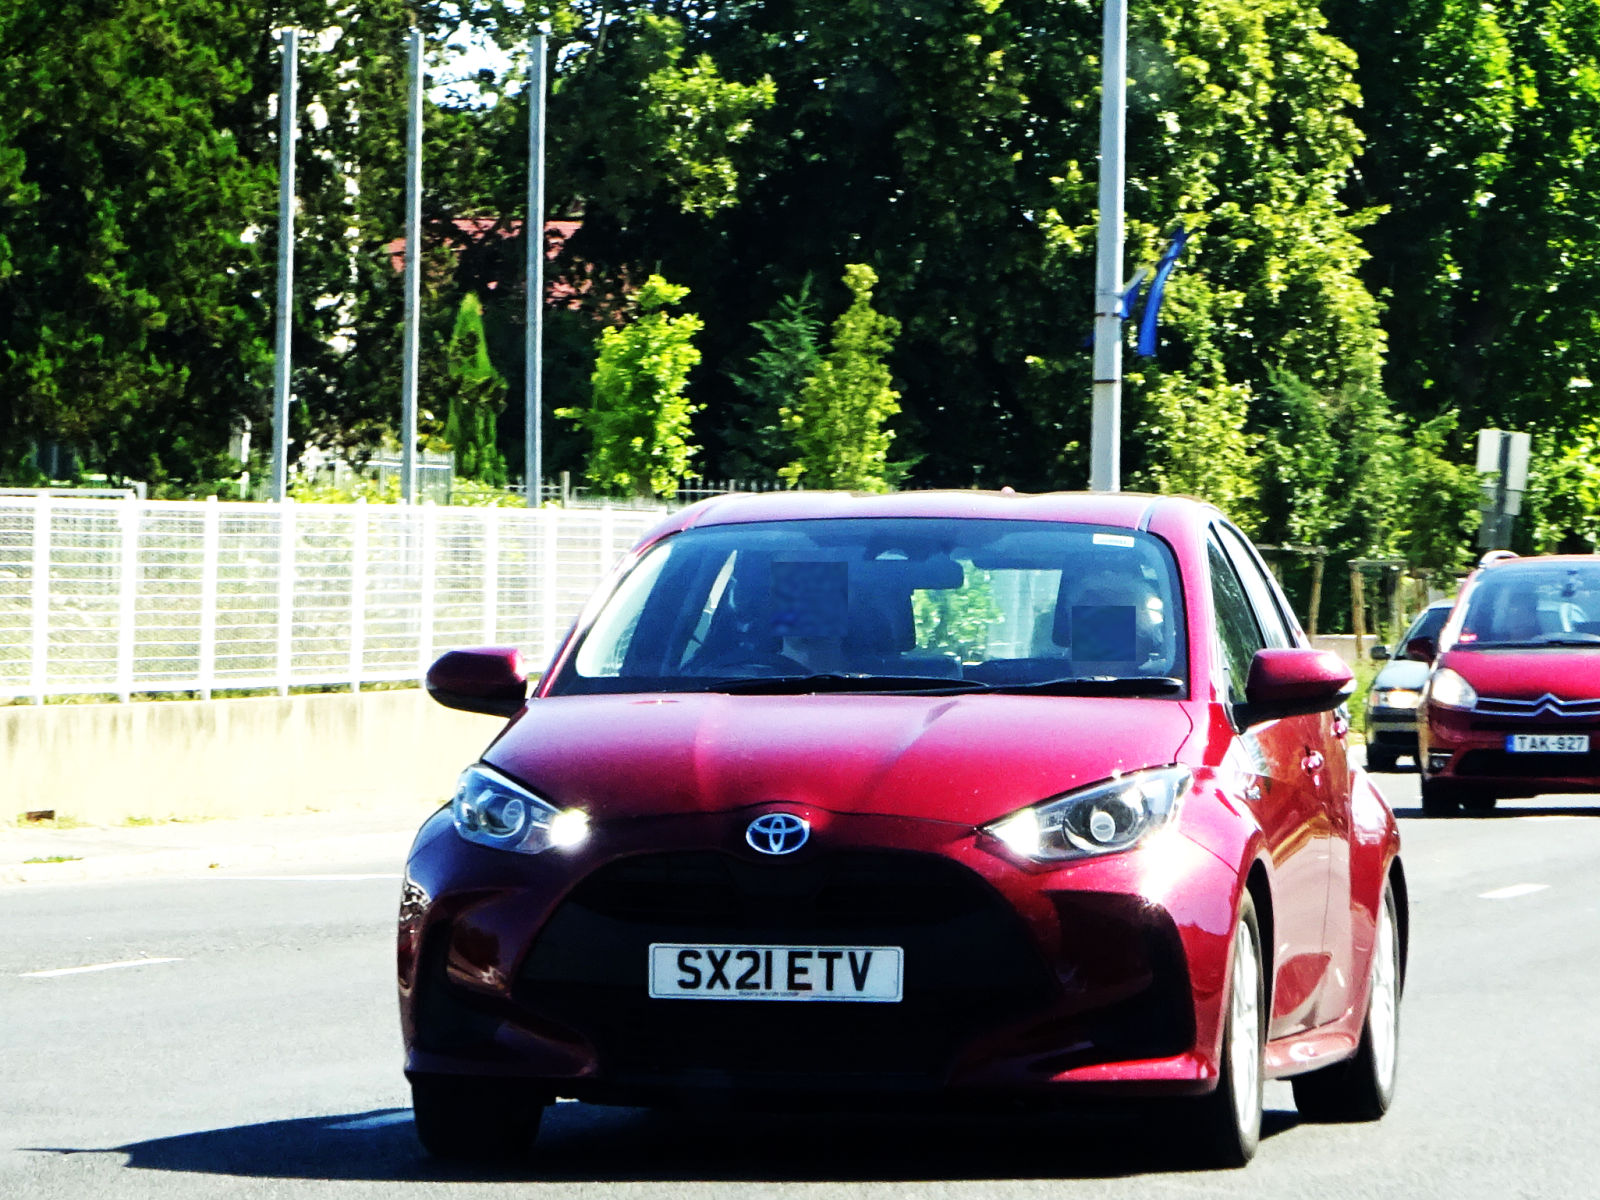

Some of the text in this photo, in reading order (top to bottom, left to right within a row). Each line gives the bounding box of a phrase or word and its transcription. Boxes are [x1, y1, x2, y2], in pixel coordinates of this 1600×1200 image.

[1518, 736, 1584, 751] TAK-927
[677, 950, 873, 991] SX21 ETV
